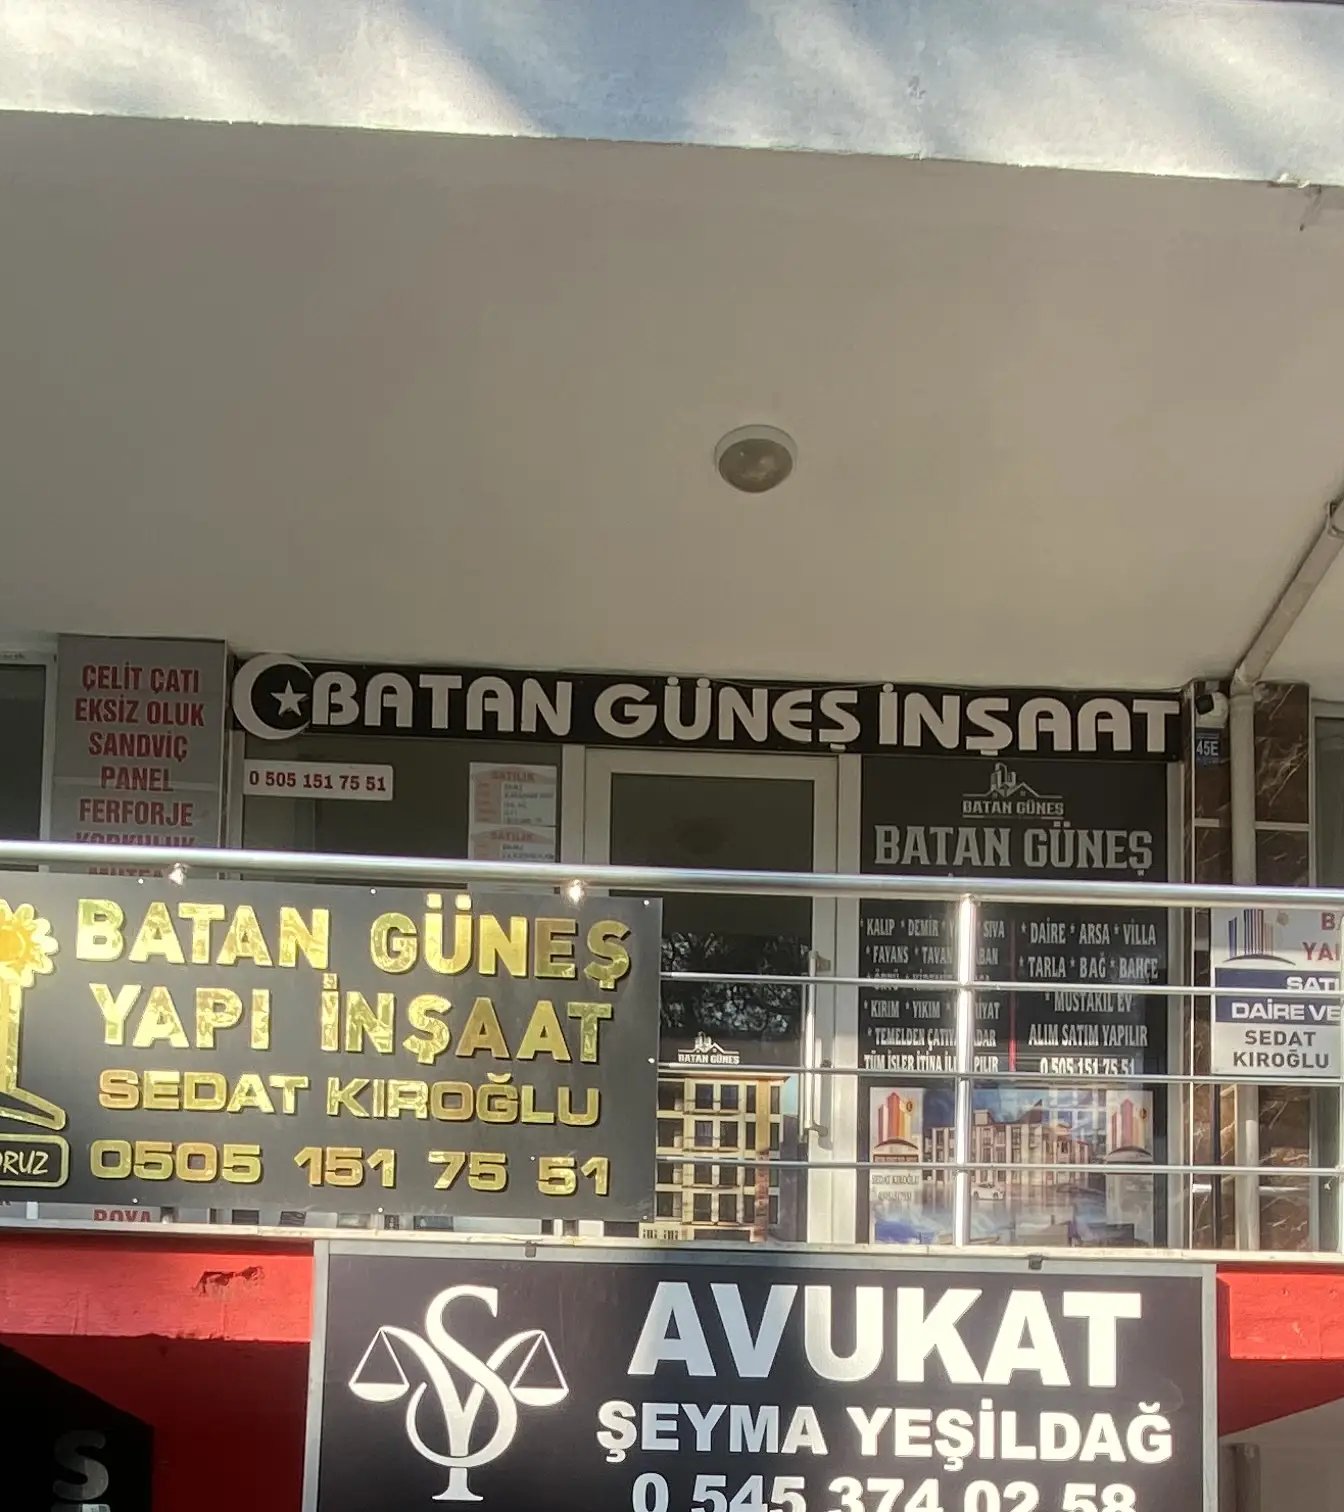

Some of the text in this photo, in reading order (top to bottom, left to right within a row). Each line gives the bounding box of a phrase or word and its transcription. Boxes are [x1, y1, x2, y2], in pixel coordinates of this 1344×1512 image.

[149, 665, 200, 695] ÇATI
[75, 693, 205, 728] EKSİZ OLUK
[312, 670, 1180, 755] BATAN GÜNEŞ İNŞAAT
[88, 731, 188, 762] SANDVİÇ
[1196, 737, 1219, 757] 45E
[100, 765, 173, 792] PANEL
[265, 771, 387, 792] 505 151 75 51
[79, 798, 194, 827] FERFORJE
[962, 800, 1012, 814] BATAN
[873, 820, 1153, 876] BATAN GÜNEŞ
[75, 894, 633, 992] BATAN GÜNEŞ
[1079, 923, 1110, 945] ARSA
[1028, 956, 1067, 979] TARLA
[89, 972, 613, 1066] YAPI İNŞAAT
[1231, 998, 1342, 1021] DAİRE VE
[875, 1027, 925, 1046] TEMELDEN
[1028, 1024, 1148, 1047] ALIM SATIM YAPILIR
[1244, 1029, 1317, 1048] SEDAT
[1233, 1044, 1330, 1069] KIROĞLU
[98, 1068, 600, 1128] SEDAT KIROĞLU
[89, 1138, 611, 1196] 0505 151 75 51
[628, 1281, 1143, 1387] AVUKAT
[597, 1398, 1173, 1472] ŞEYMA YEŞİLDAĞ
